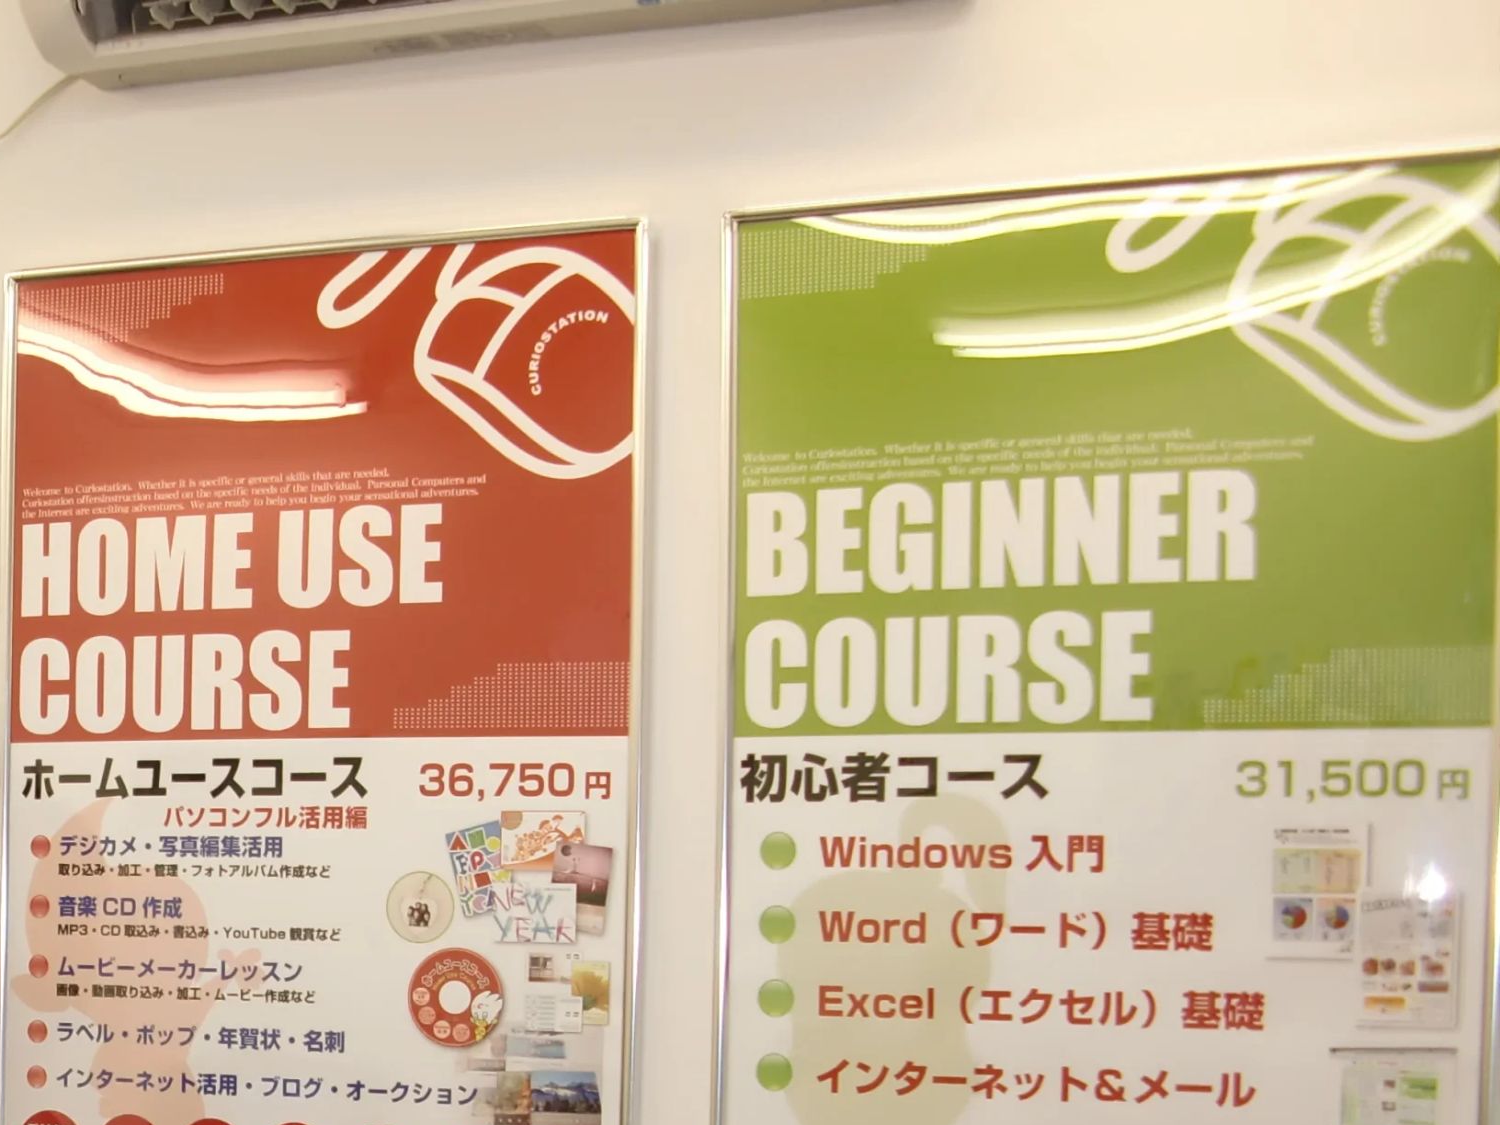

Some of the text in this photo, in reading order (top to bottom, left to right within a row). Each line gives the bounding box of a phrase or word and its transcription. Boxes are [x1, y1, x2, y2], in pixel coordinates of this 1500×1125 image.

[529, 309, 609, 396] CURIOSTATION
[746, 468, 1257, 597] BEGINNER
[22, 503, 443, 618] HOME USE
[19, 629, 351, 735] COURSE
[744, 609, 1153, 729] COURSE
[22, 757, 369, 800] ホームユースコース
[739, 753, 1049, 804] 初心者コース
[164, 806, 368, 830] パソコンフル活用編
[59, 835, 283, 859] デジカメ・写真編集活用
[57, 958, 302, 982] ムービーメーカーレッスン
[57, 1021, 344, 1054] ラベル・ポップ・年賀状・名刺
[56, 1069, 478, 1107] インターネット活用・ブログ・オークション
